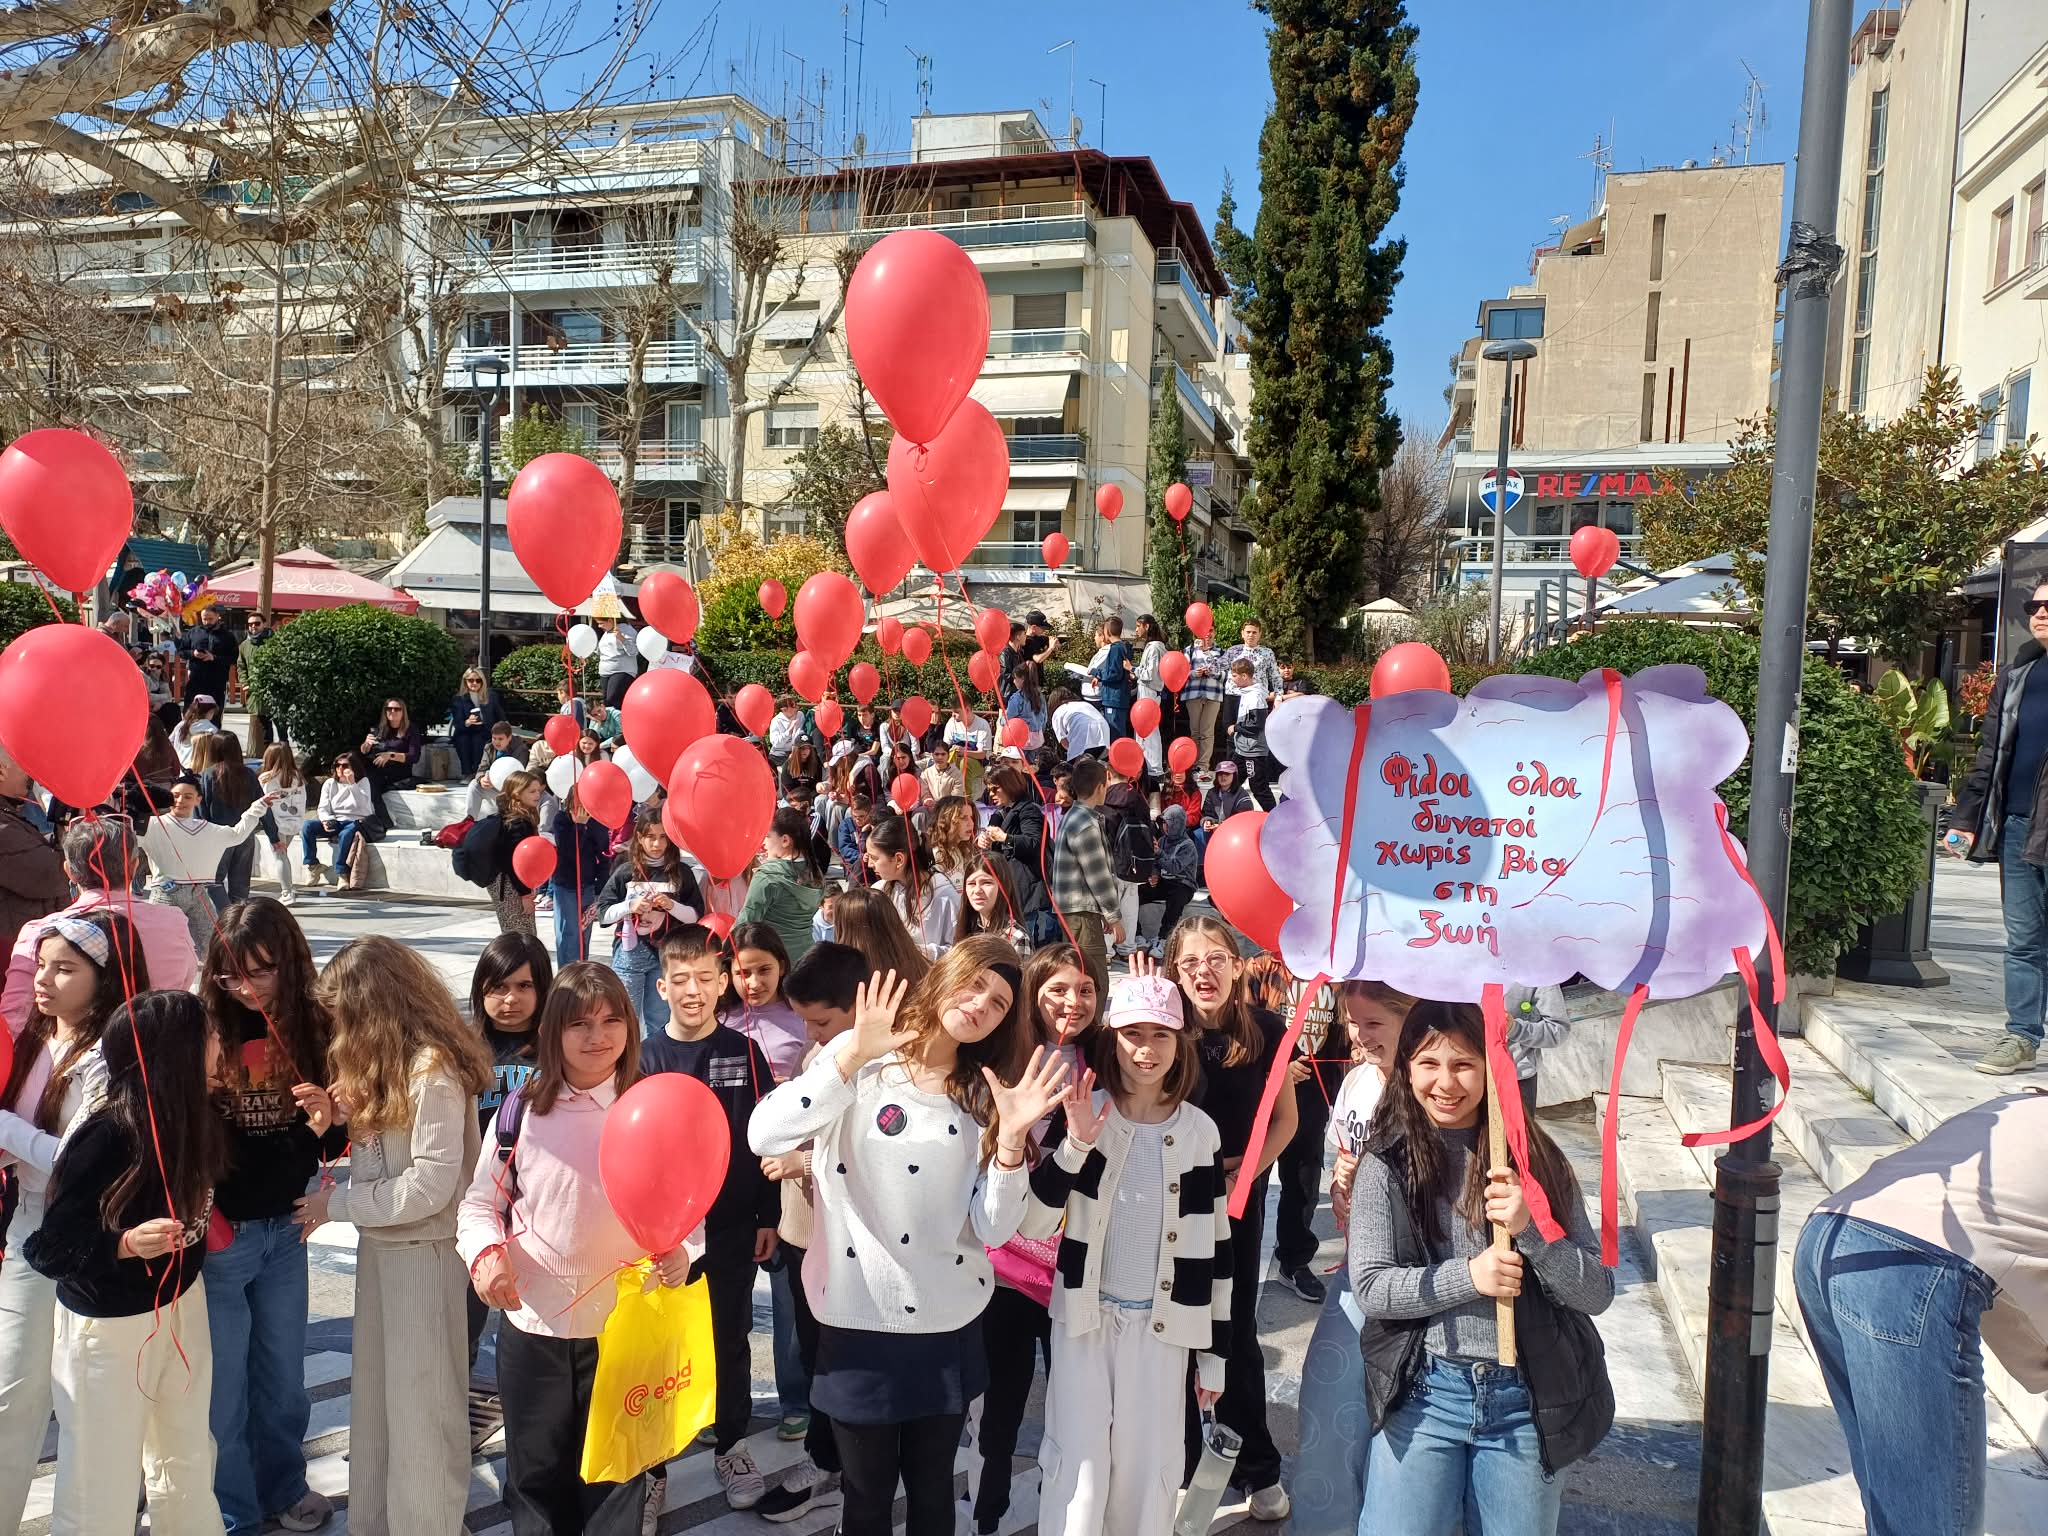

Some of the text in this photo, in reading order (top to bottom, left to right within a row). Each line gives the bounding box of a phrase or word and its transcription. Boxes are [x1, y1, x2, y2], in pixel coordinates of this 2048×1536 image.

[1485, 480, 1519, 490] REAX
[1380, 751, 1473, 799] Φίλοι
[1412, 799, 1538, 838] δυνατοί
[1498, 843, 1567, 879] βία
[1433, 881, 1498, 906] στη
